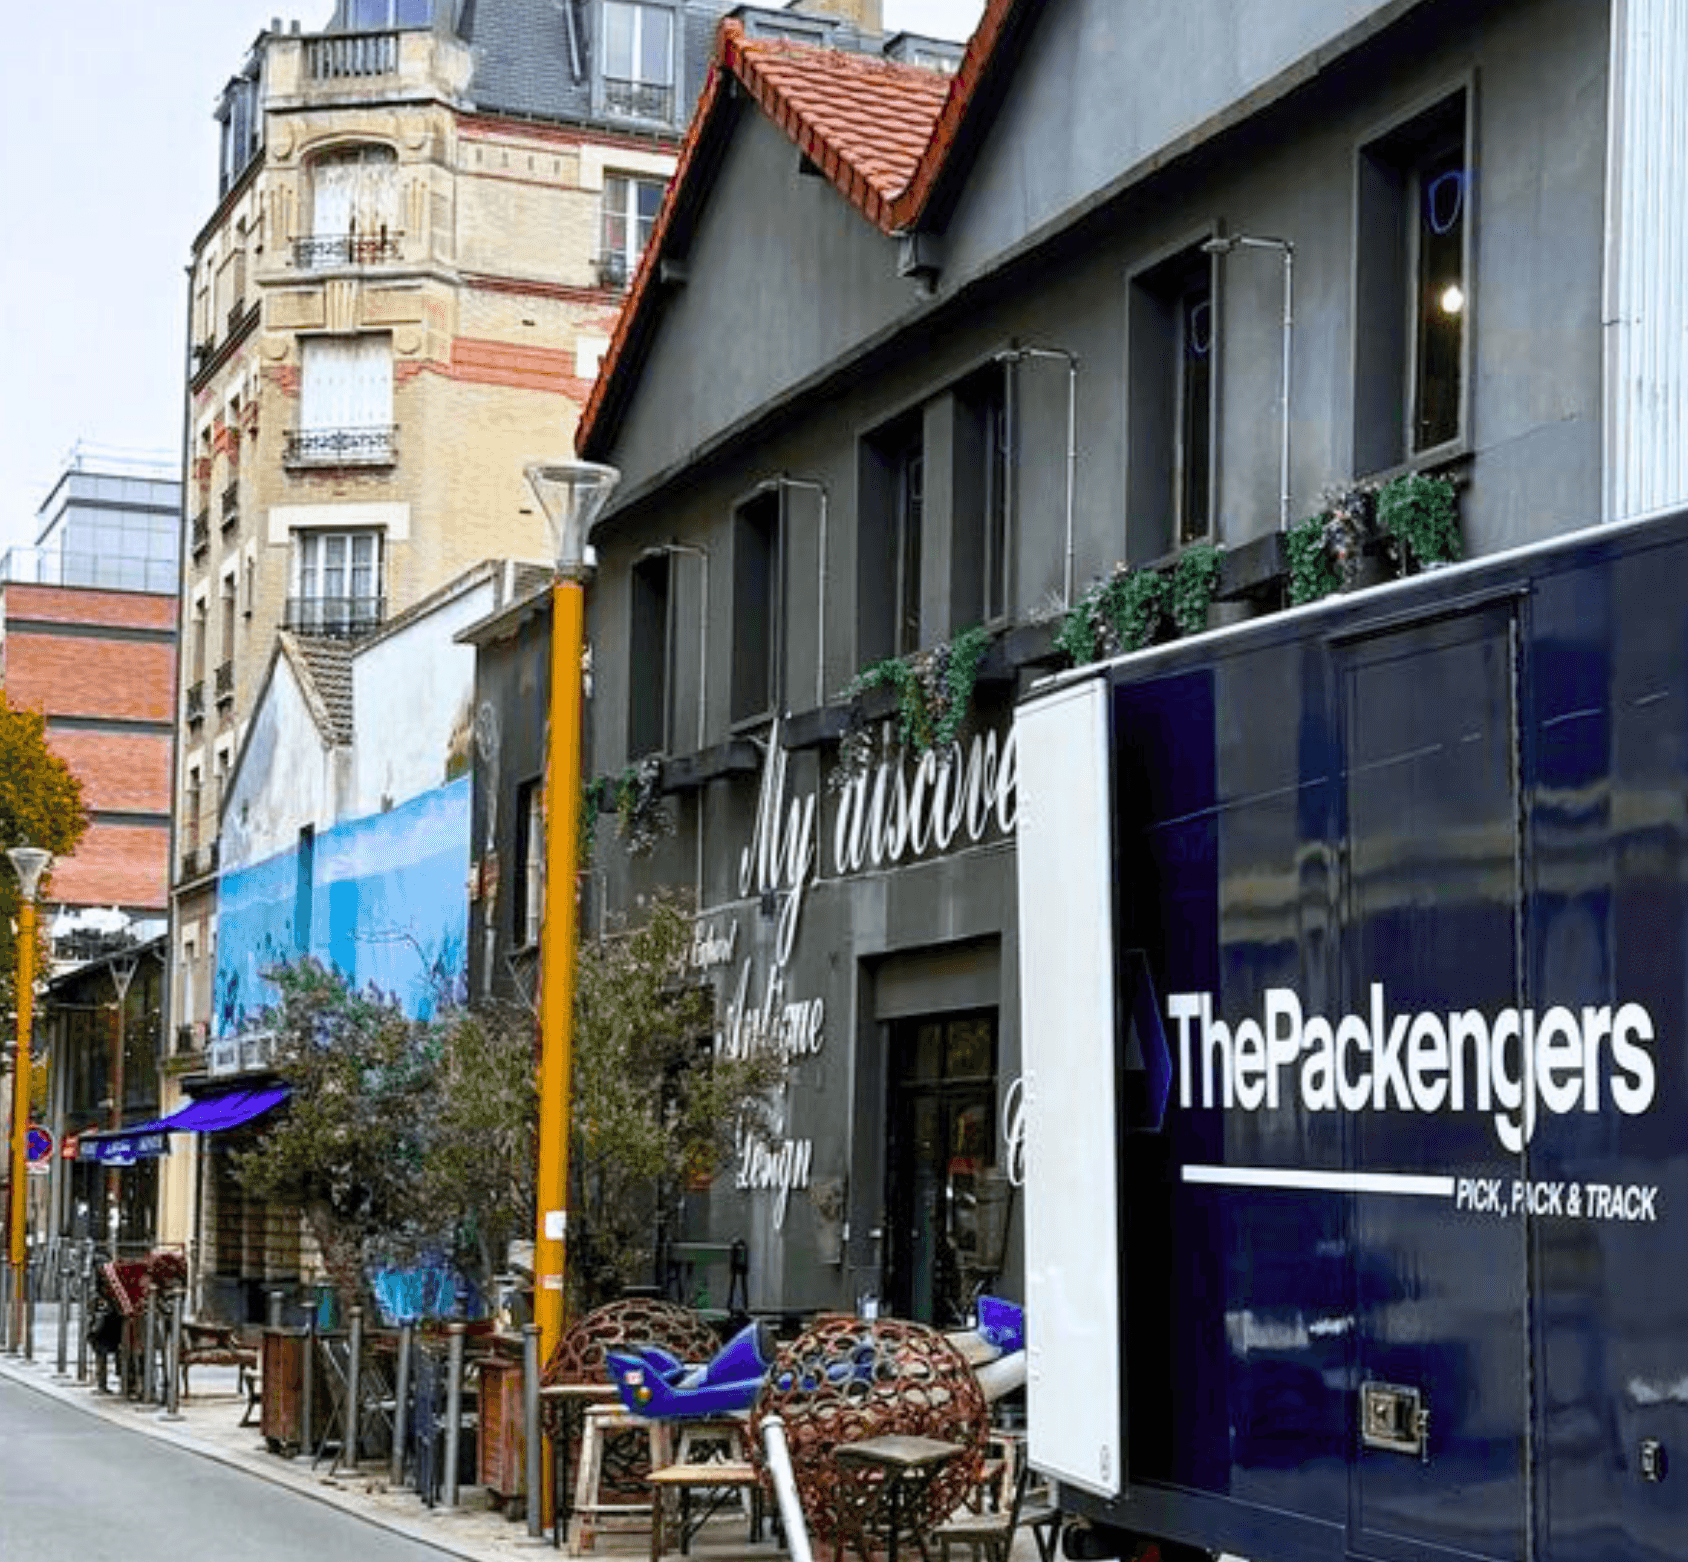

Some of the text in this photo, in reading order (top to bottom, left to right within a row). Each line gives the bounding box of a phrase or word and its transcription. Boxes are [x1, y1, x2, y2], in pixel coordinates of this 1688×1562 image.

[739, 716, 816, 967] My
[1167, 982, 1656, 1154] ThePackengers
[1457, 1178, 1508, 1218] PICK,
[1566, 1181, 1582, 1217] &
[1585, 1184, 1658, 1221] TRACK
